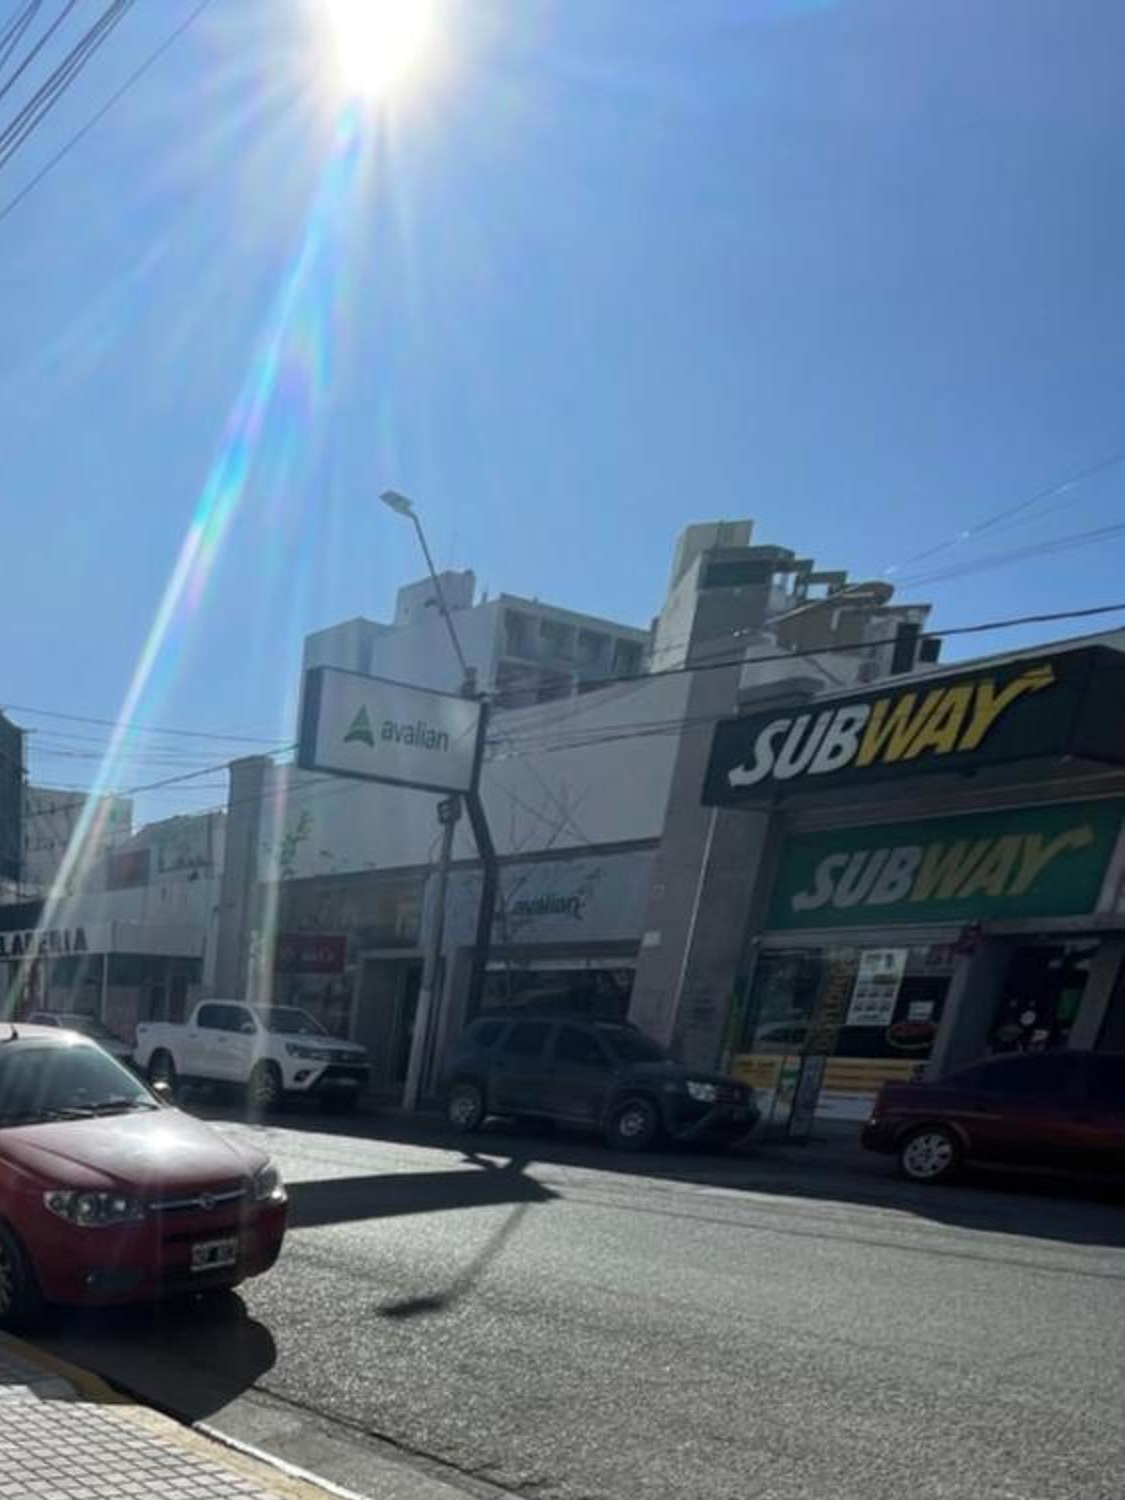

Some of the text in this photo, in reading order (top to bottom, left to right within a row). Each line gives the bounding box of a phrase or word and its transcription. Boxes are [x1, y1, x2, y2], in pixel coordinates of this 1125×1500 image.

[381, 721, 449, 752] avalian
[728, 664, 1056, 787] SUBWAY
[792, 823, 1094, 911] SUBWAY
